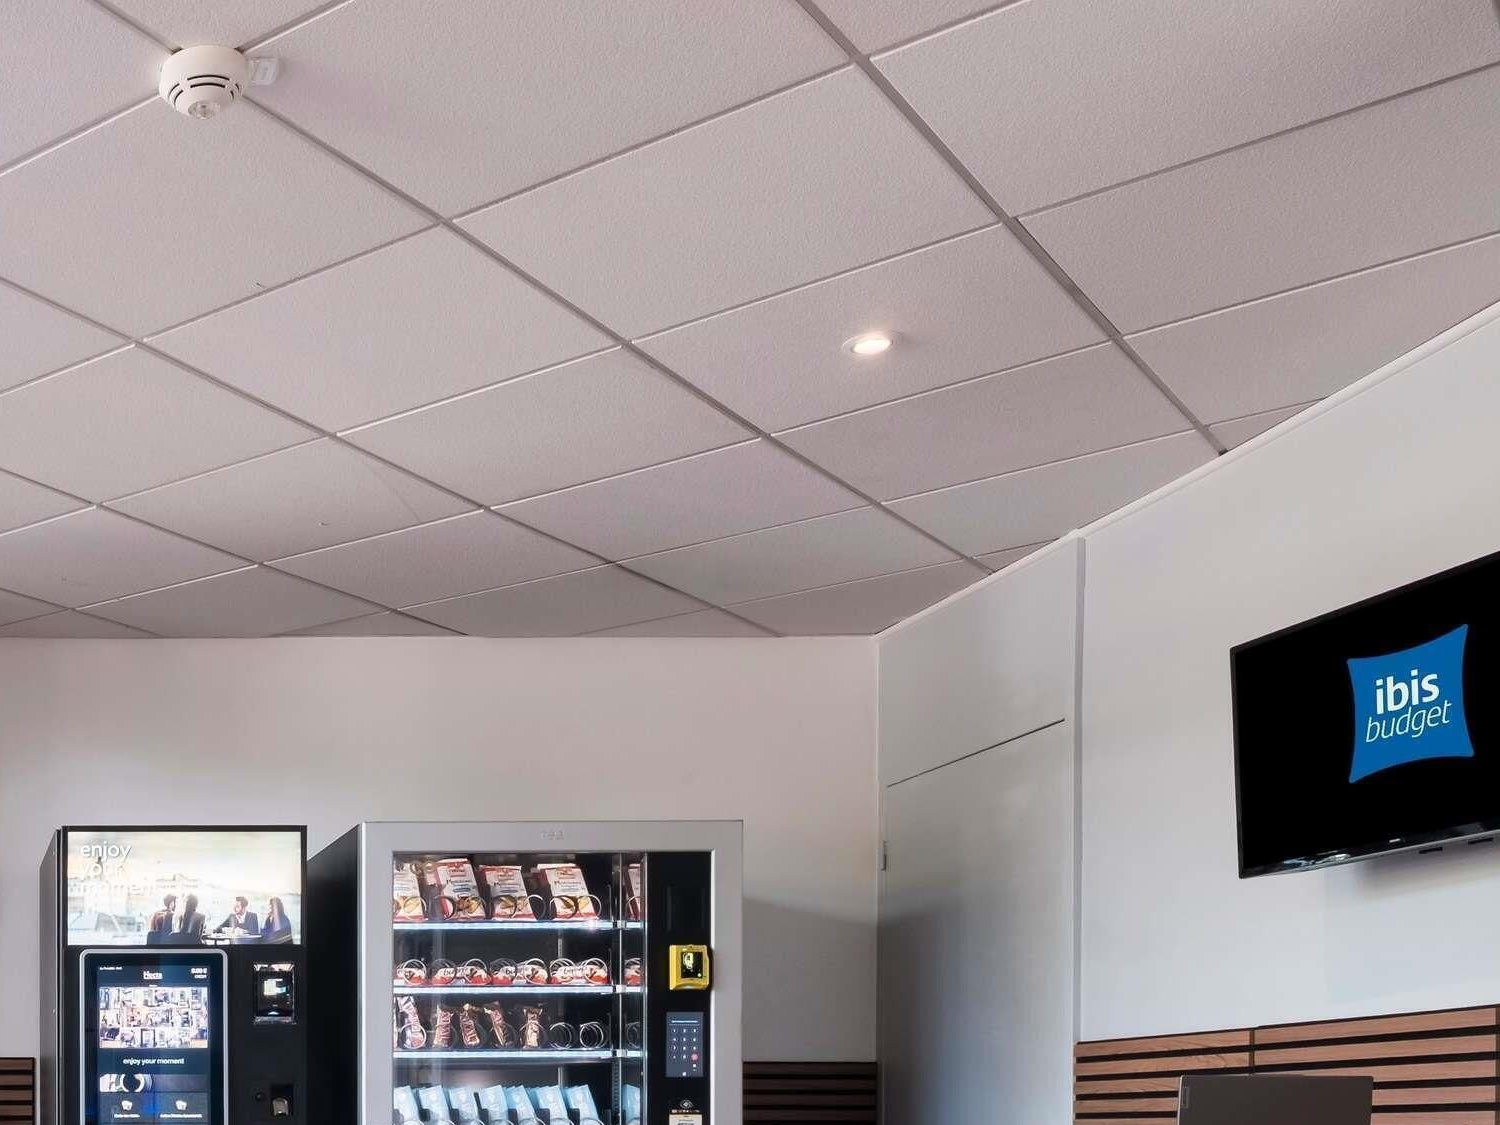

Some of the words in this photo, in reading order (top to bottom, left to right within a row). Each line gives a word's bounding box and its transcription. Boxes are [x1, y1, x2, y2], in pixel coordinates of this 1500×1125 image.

[1376, 669, 1440, 715] ibis
[1365, 700, 1453, 743] budget
[81, 840, 132, 864] enjoy
[122, 1057, 140, 1066] enjoy
[141, 1058, 156, 1066] your
